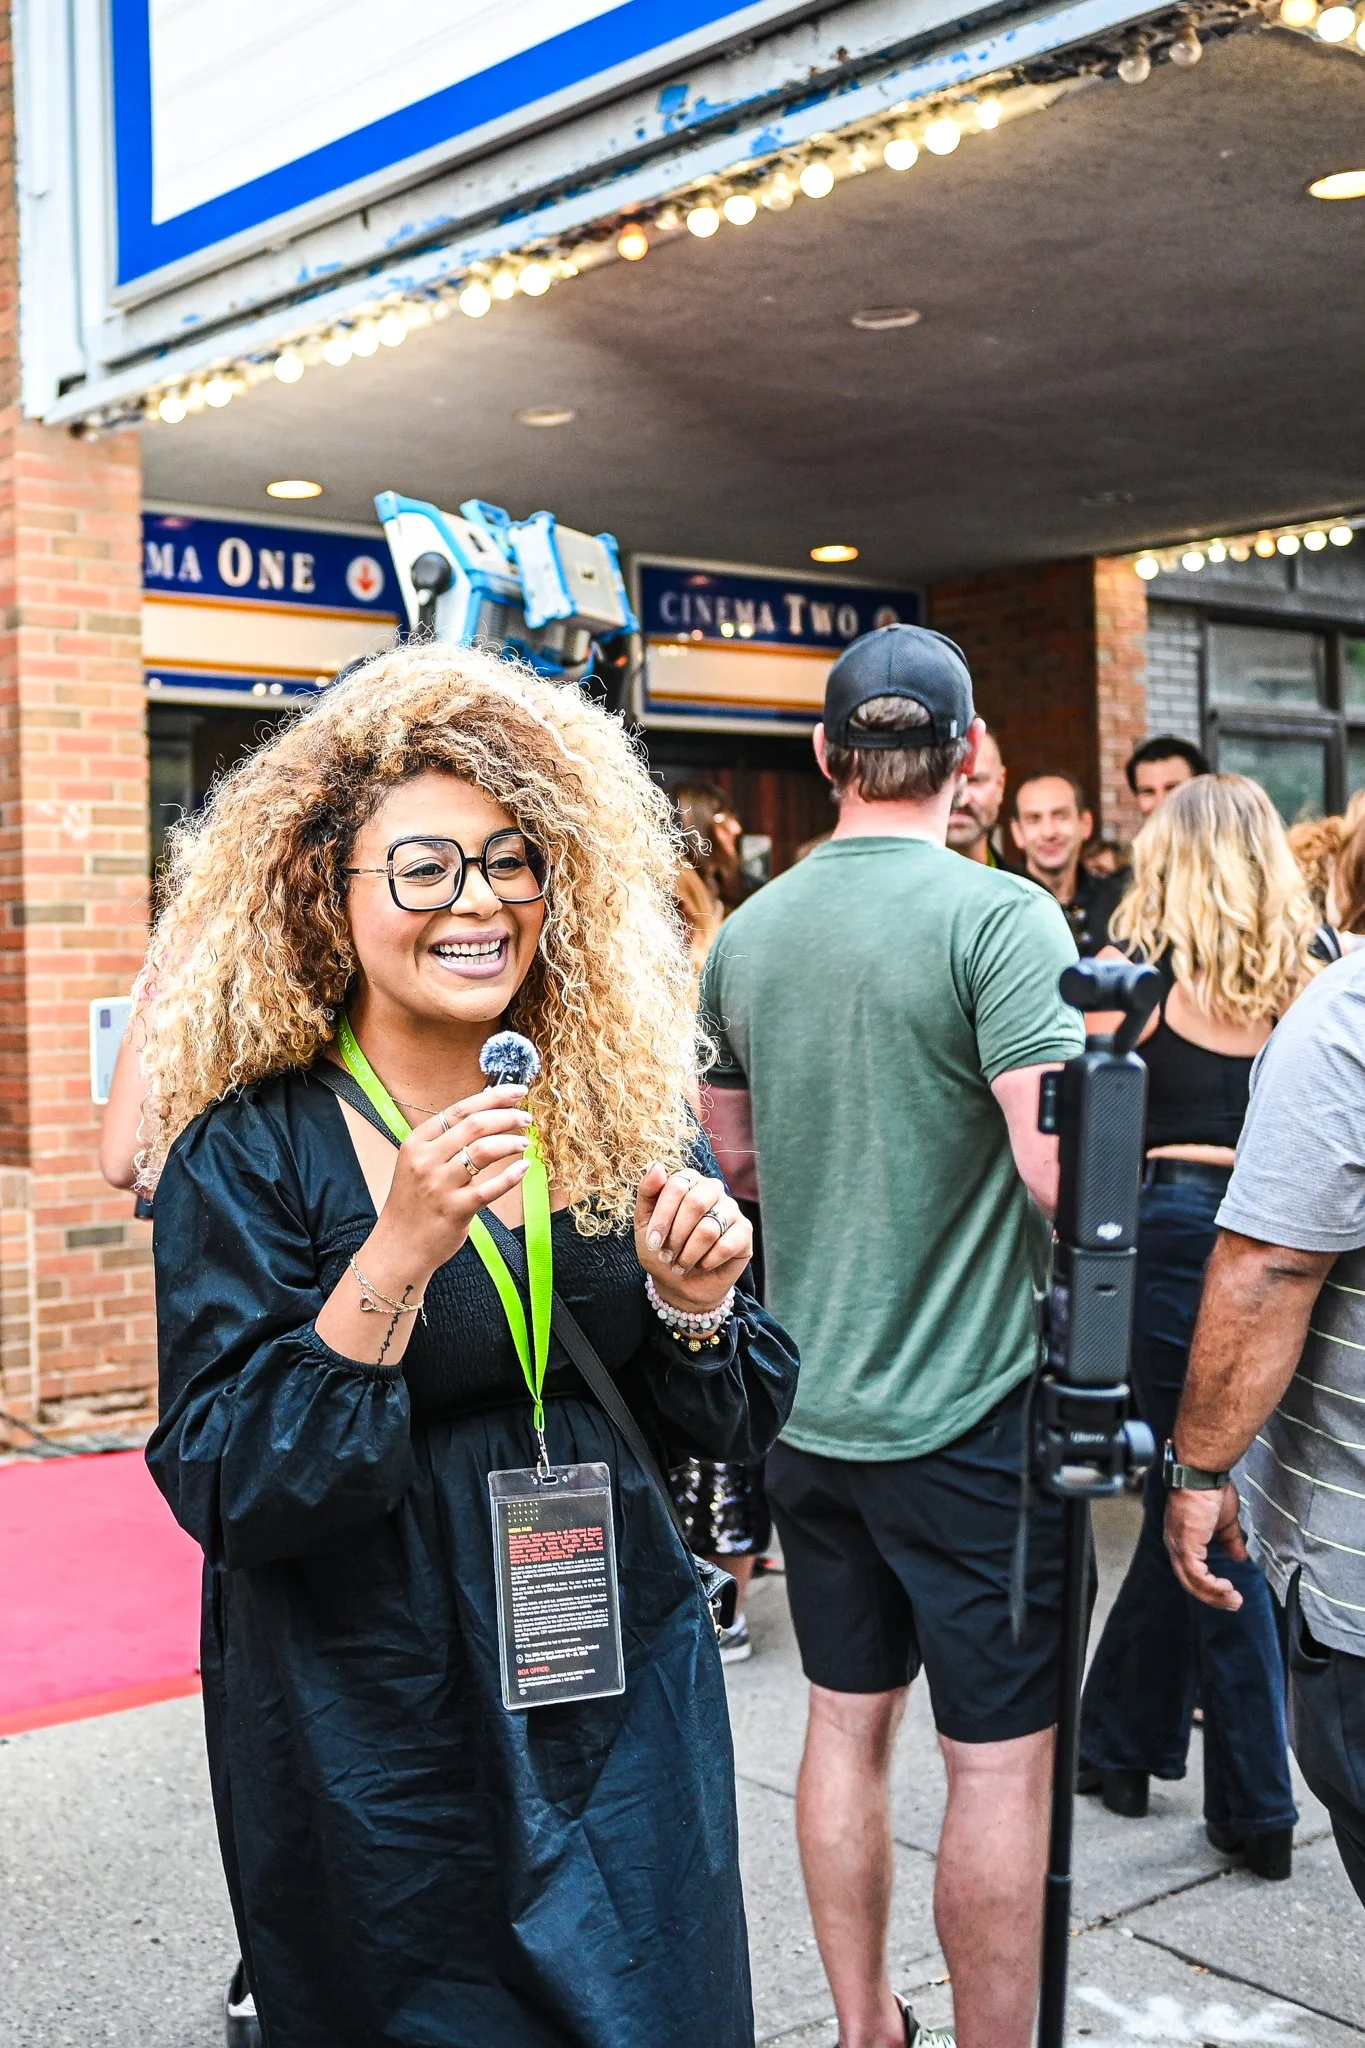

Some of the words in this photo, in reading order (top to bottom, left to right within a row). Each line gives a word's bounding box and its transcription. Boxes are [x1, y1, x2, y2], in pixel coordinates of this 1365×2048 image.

[217, 537, 316, 593] ONE
[659, 591, 775, 635] CINEMA
[785, 592, 859, 638] TWO
[341, 1032, 360, 1067] servus
